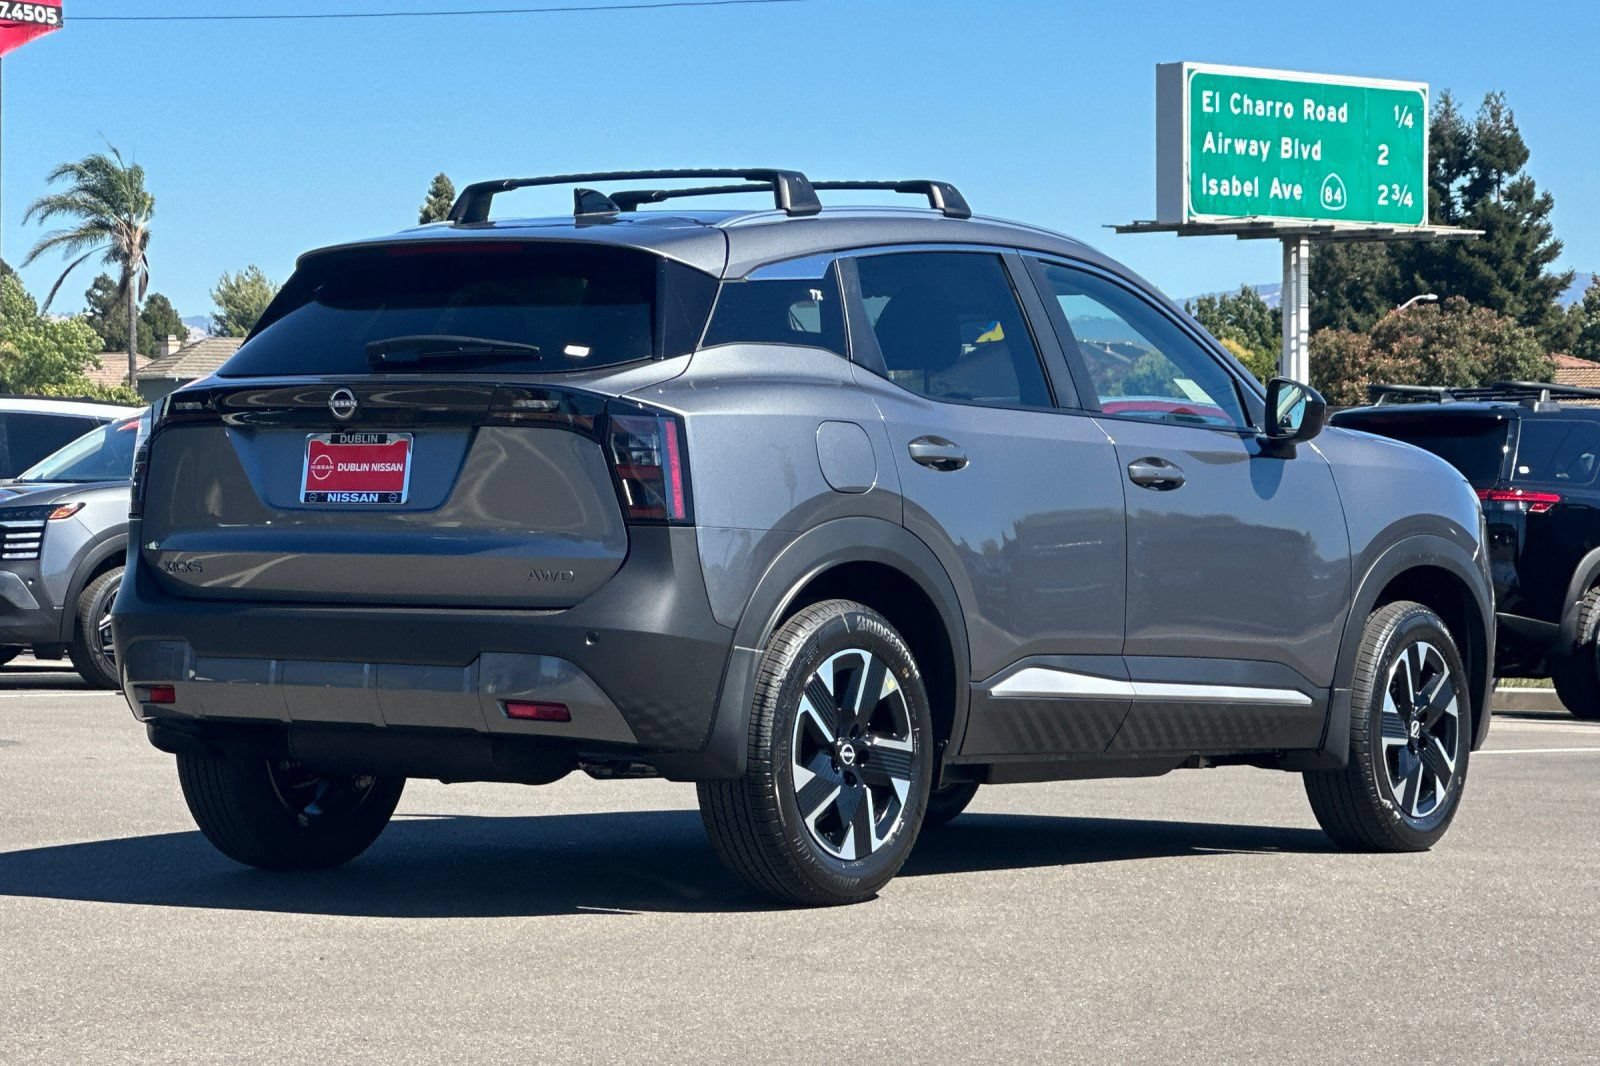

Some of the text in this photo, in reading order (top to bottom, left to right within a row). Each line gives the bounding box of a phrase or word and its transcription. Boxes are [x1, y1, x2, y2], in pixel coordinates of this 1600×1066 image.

[1202, 90, 1220, 113] El
[1229, 93, 1294, 119] Charro
[1303, 98, 1348, 123] Road
[1203, 131, 1389, 166] Airway Blvd 2
[1202, 173, 1259, 198] Isabel
[1270, 177, 1303, 200] Ave
[1324, 186, 1342, 203] 84
[340, 434, 378, 444] DUBLIN
[337, 463, 404, 472] DUBLIN NISSAN
[327, 493, 379, 502] NISSAN
[164, 560, 203, 573] KICKS
[527, 569, 575, 581] AWD
